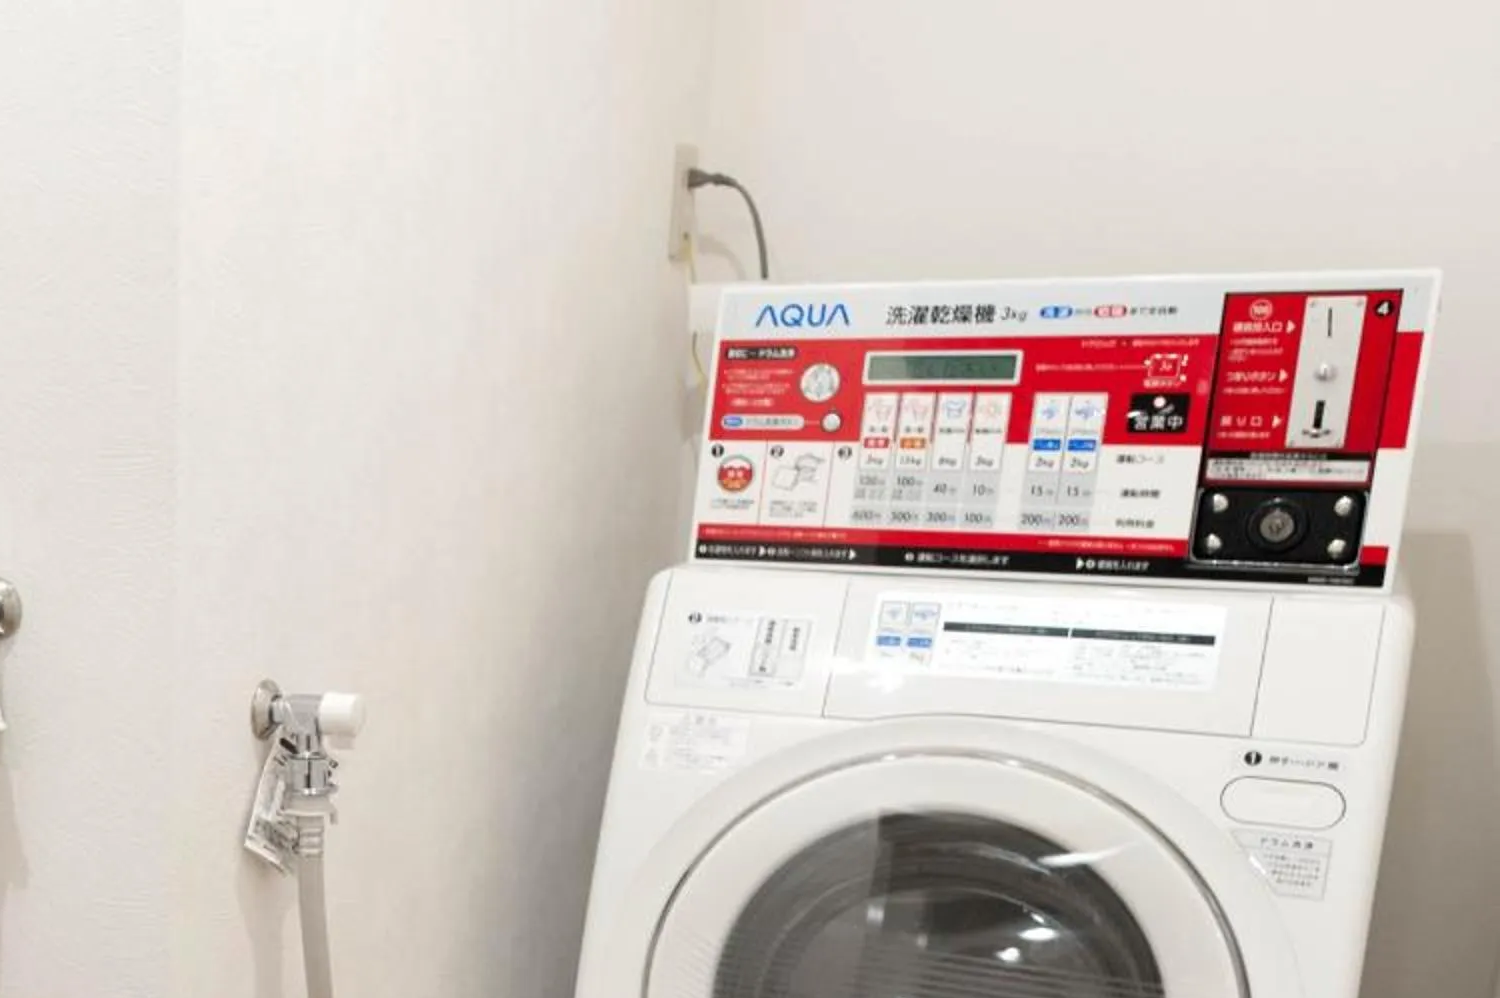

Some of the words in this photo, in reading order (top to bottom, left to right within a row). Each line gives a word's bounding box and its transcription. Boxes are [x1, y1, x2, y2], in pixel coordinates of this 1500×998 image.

[755, 303, 850, 328] AQUA
[886, 304, 996, 325] 洗濯乾燥機
[1000, 307, 1028, 323] 3kg
[1376, 302, 1391, 317] 4
